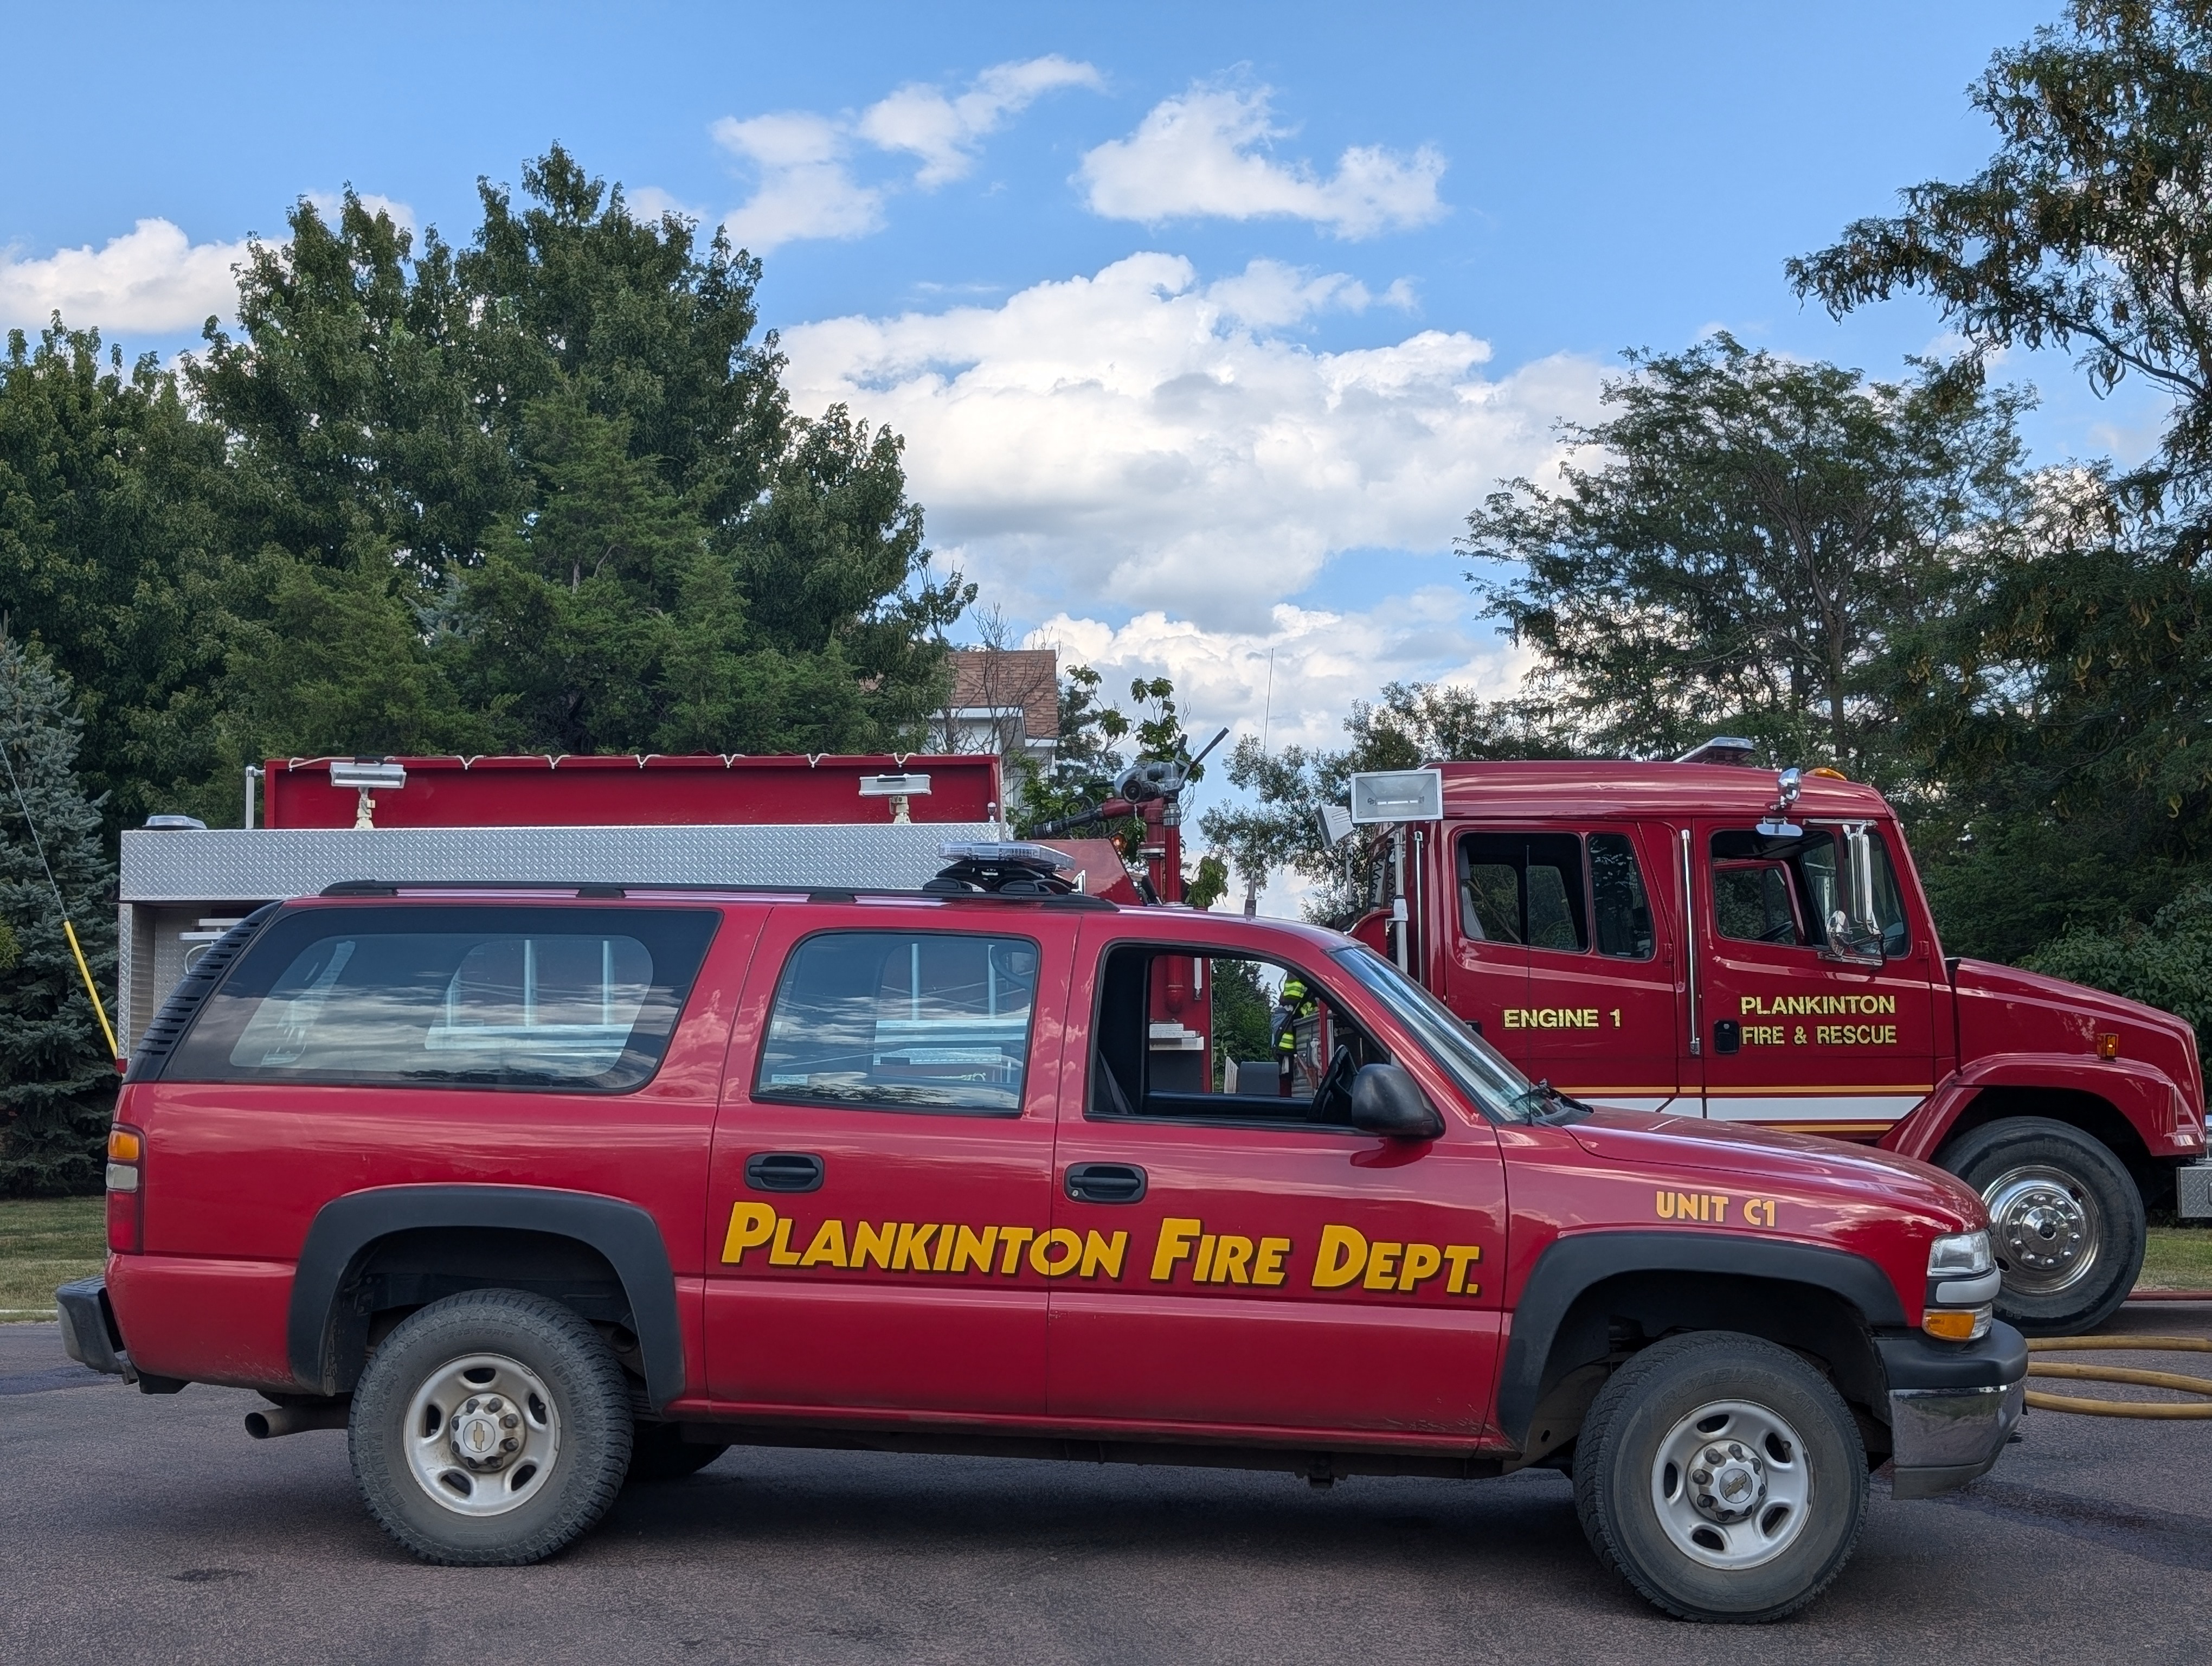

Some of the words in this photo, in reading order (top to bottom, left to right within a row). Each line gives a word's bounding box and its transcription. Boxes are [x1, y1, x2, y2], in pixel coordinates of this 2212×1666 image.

[1741, 995, 1896, 1015] PLANKINTON
[1504, 1008, 1599, 1028] ENGINE
[1609, 1008, 1621, 1028] 1
[1742, 1026, 1784, 1045] FIRE
[1794, 1026, 1807, 1045] &
[1816, 1025, 1896, 1045] RESCUE
[1656, 1191, 1729, 1222] UNIT
[1743, 1199, 1776, 1227] C1
[721, 1201, 1129, 1279] PLANKINTON
[1150, 1218, 1291, 1286] FIRE
[1311, 1224, 1481, 1295] DEPT.
